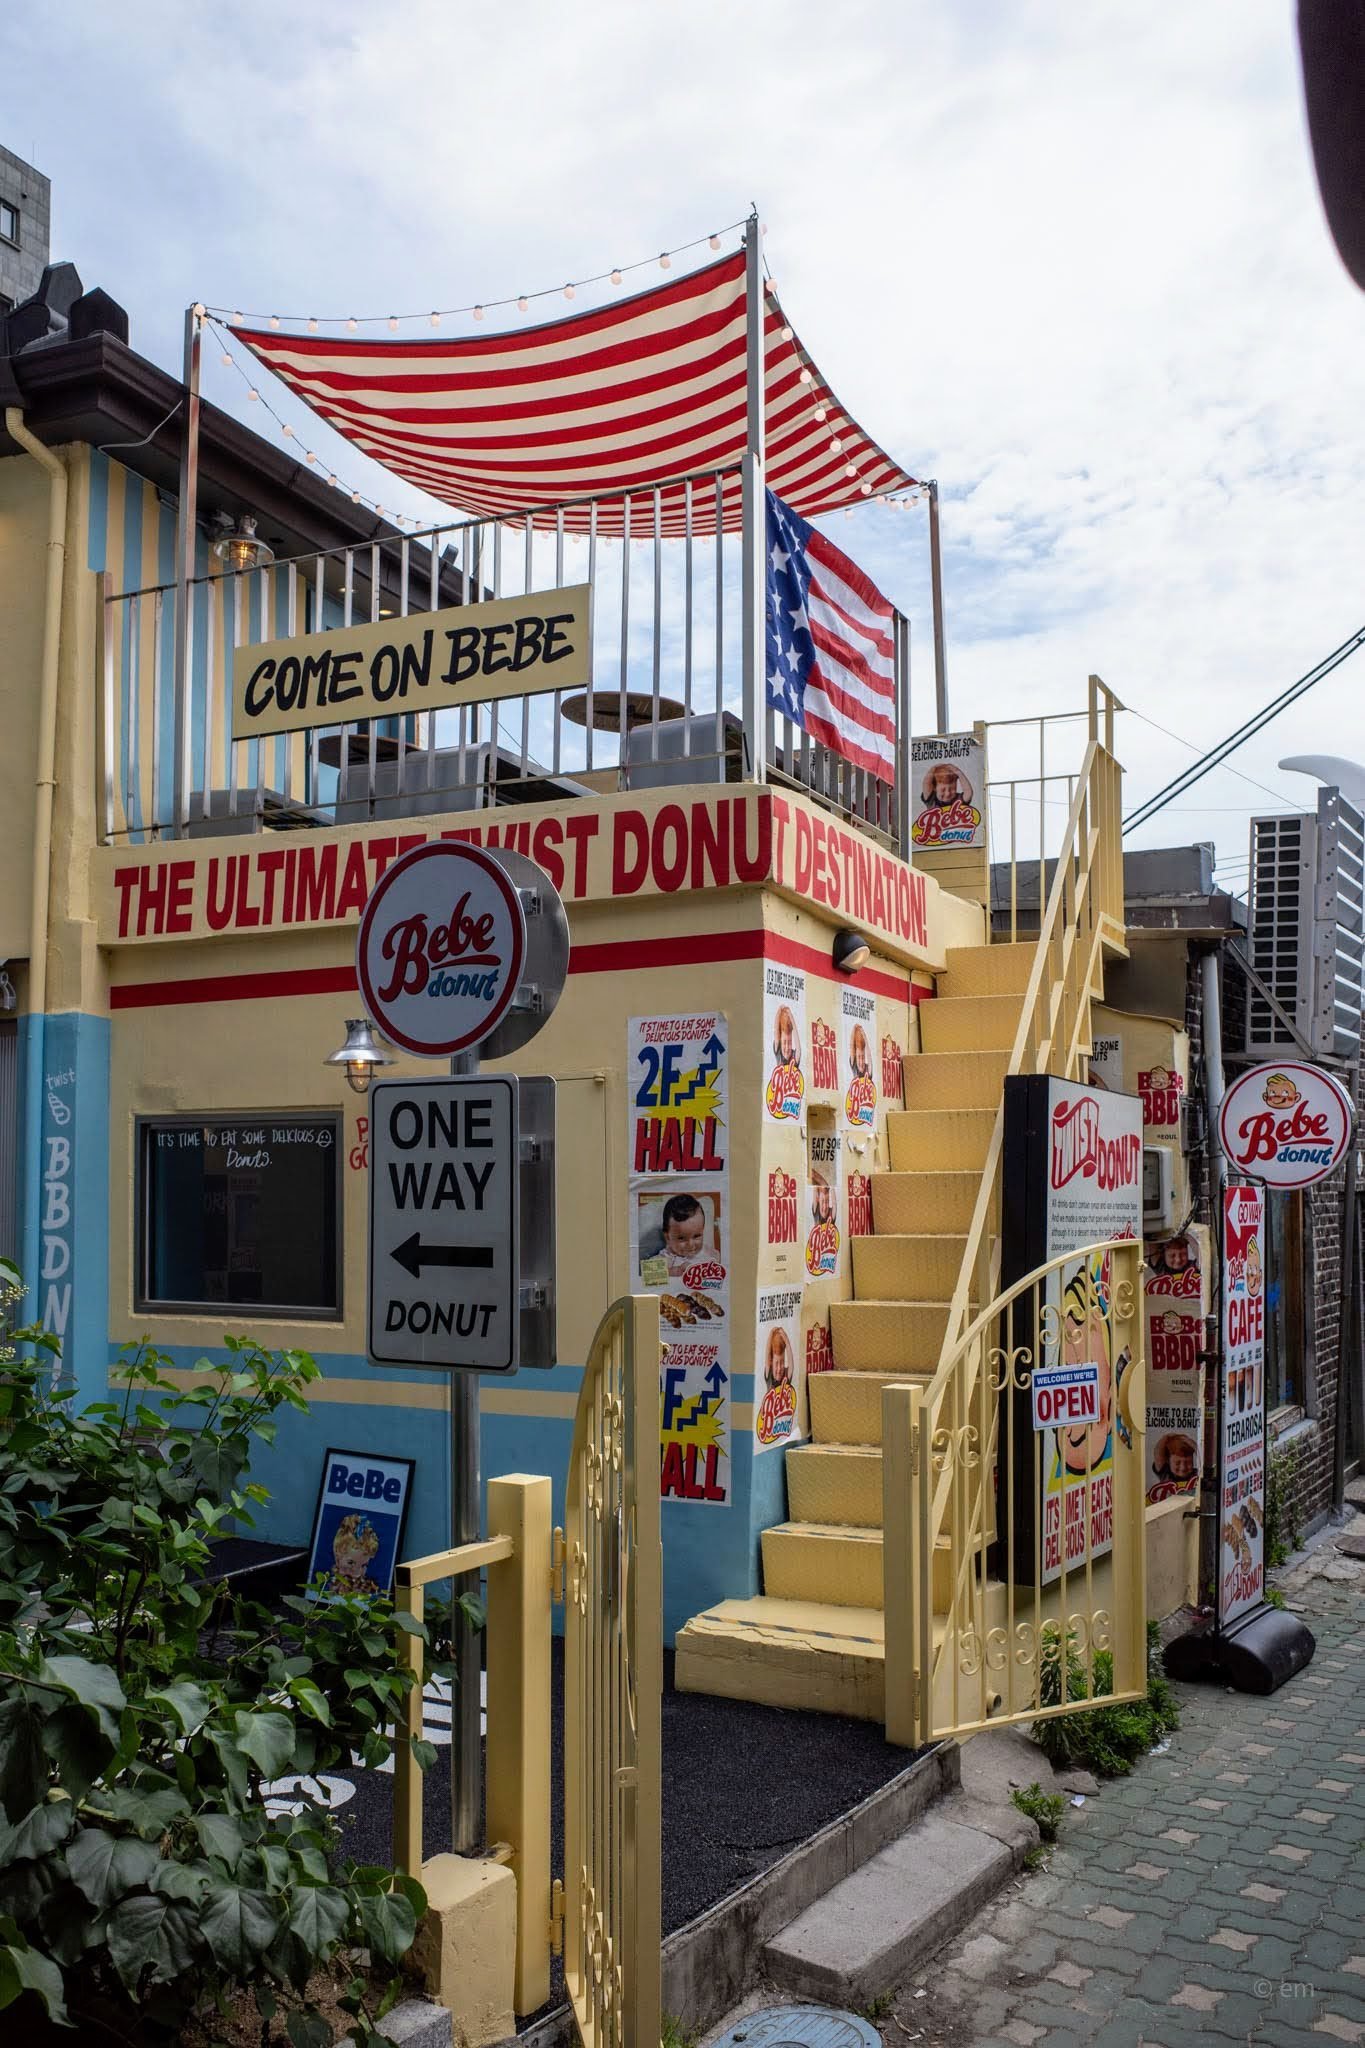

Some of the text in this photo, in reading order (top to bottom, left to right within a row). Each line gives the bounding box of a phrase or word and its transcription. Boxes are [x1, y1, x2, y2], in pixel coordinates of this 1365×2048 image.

[245, 614, 575, 716] COME ON BEBE
[912, 743, 921, 752] T'S
[950, 739, 962, 749] EAT
[944, 747, 970, 759] DONUTS
[917, 801, 973, 842] Bebe
[941, 830, 973, 841] donut
[115, 860, 195, 938] THE
[205, 834, 428, 932] ULTIMAT
[611, 793, 790, 896] DONUT
[795, 806, 929, 948] DESTINATION!
[378, 891, 496, 1003] Bebe
[428, 969, 500, 1001] donut
[645, 1030, 712, 1043] DELICIOUS DONUTS
[696, 1018, 716, 1029] SOME
[1090, 1052, 1108, 1062] NUTS
[1100, 1041, 1119, 1051] SOME
[46, 1068, 77, 1090] twist
[636, 1045, 684, 1107] 2F
[769, 1058, 801, 1113] Bebe
[812, 1046, 839, 1091] BBDN
[783, 1097, 800, 1117] donut
[848, 1073, 874, 1118] Bebe
[158, 1133, 175, 1148] IT'S
[179, 1132, 201, 1148] TIME
[222, 1131, 237, 1146] EAT
[242, 1128, 266, 1145] SOME
[272, 1128, 315, 1144] DELICIOUS
[389, 1099, 494, 1150] ONE
[1237, 1100, 1330, 1165] Bebe
[635, 1116, 725, 1173] HALL
[812, 1138, 826, 1150] EAT
[812, 1150, 835, 1162] ONUTS
[1277, 1147, 1333, 1166] donut
[1098, 1134, 1141, 1192] DONUT
[388, 1162, 495, 1211] WAY
[768, 1198, 798, 1244] BBDN
[1238, 1202, 1263, 1224] GO WAY
[809, 1217, 836, 1271] Bebe
[687, 1261, 721, 1288] Bebe
[385, 1300, 497, 1338] DONUT
[1229, 1296, 1263, 1348] CAFE
[660, 1355, 713, 1367] CIOUS DONUTS
[672, 1344, 719, 1356] TO EAT SOME
[1037, 1370, 1095, 1385] WELCOME! WE'RE
[760, 1378, 792, 1441] Bebe
[1037, 1385, 1096, 1422] OPEN
[1153, 1408, 1171, 1418] TIME
[1172, 1408, 1181, 1418] TO
[1182, 1408, 1196, 1418] EAT
[773, 1420, 793, 1435] donut
[1227, 1412, 1263, 1448] TERAROSA
[328, 1464, 402, 1504] BeBe
[661, 1442, 726, 1502] ALL
[1066, 1489, 1079, 1525] IME
[1092, 1478, 1105, 1514] EAT
[1046, 1508, 1113, 1571] DELIOUS ONUTS
